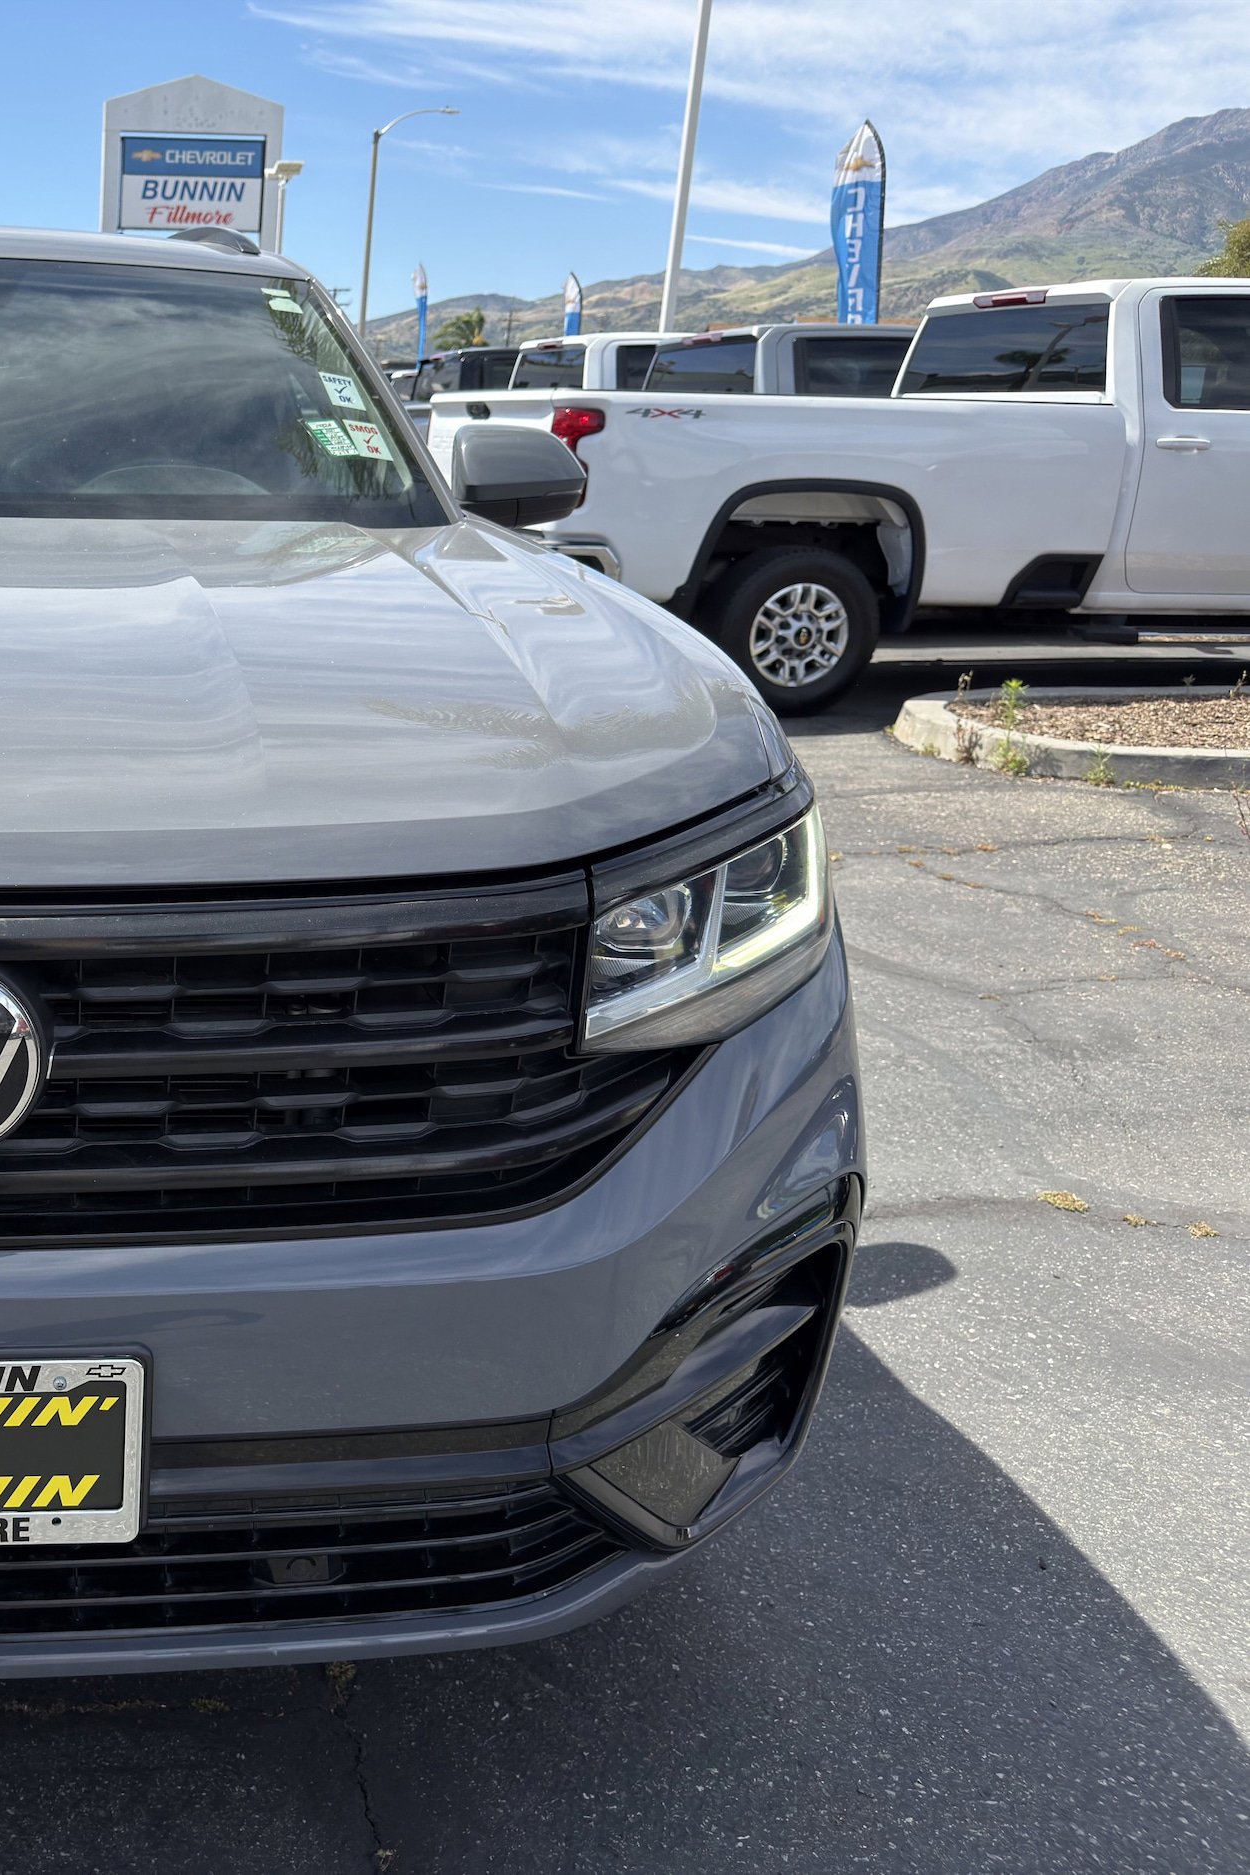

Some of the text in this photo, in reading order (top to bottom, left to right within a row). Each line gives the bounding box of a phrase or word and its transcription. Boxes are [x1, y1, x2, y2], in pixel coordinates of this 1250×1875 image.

[165, 149, 256, 166] CHEVROLET
[141, 179, 246, 203] BUNNIN
[145, 204, 236, 225] Fillmore
[322, 375, 352, 387] SAFETY
[339, 395, 354, 404] OK
[349, 424, 379, 435] SMOG
[366, 445, 381, 454] OK
